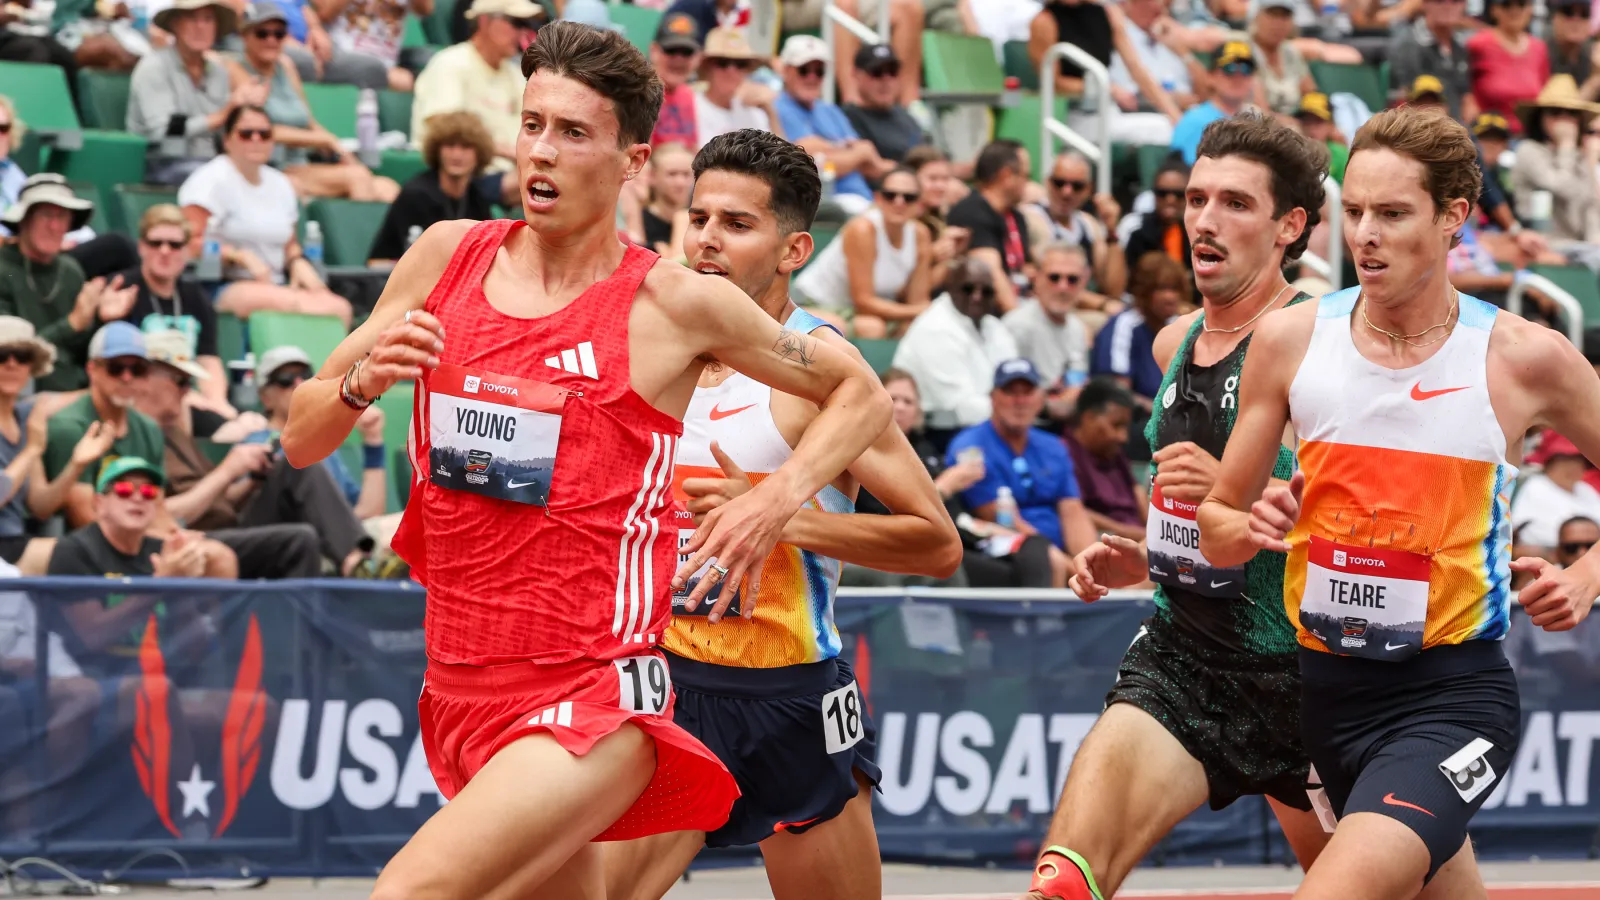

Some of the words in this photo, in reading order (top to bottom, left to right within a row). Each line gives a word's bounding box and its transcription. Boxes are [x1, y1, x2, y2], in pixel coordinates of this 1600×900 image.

[482, 382, 519, 396] TOYOTA
[456, 406, 517, 442] YOUNG
[1160, 519, 1200, 550] JACOB
[1349, 556, 1386, 568] TOYOTA
[1329, 578, 1387, 610] TEARE
[622, 658, 666, 713] 19
[827, 690, 859, 745] 18
